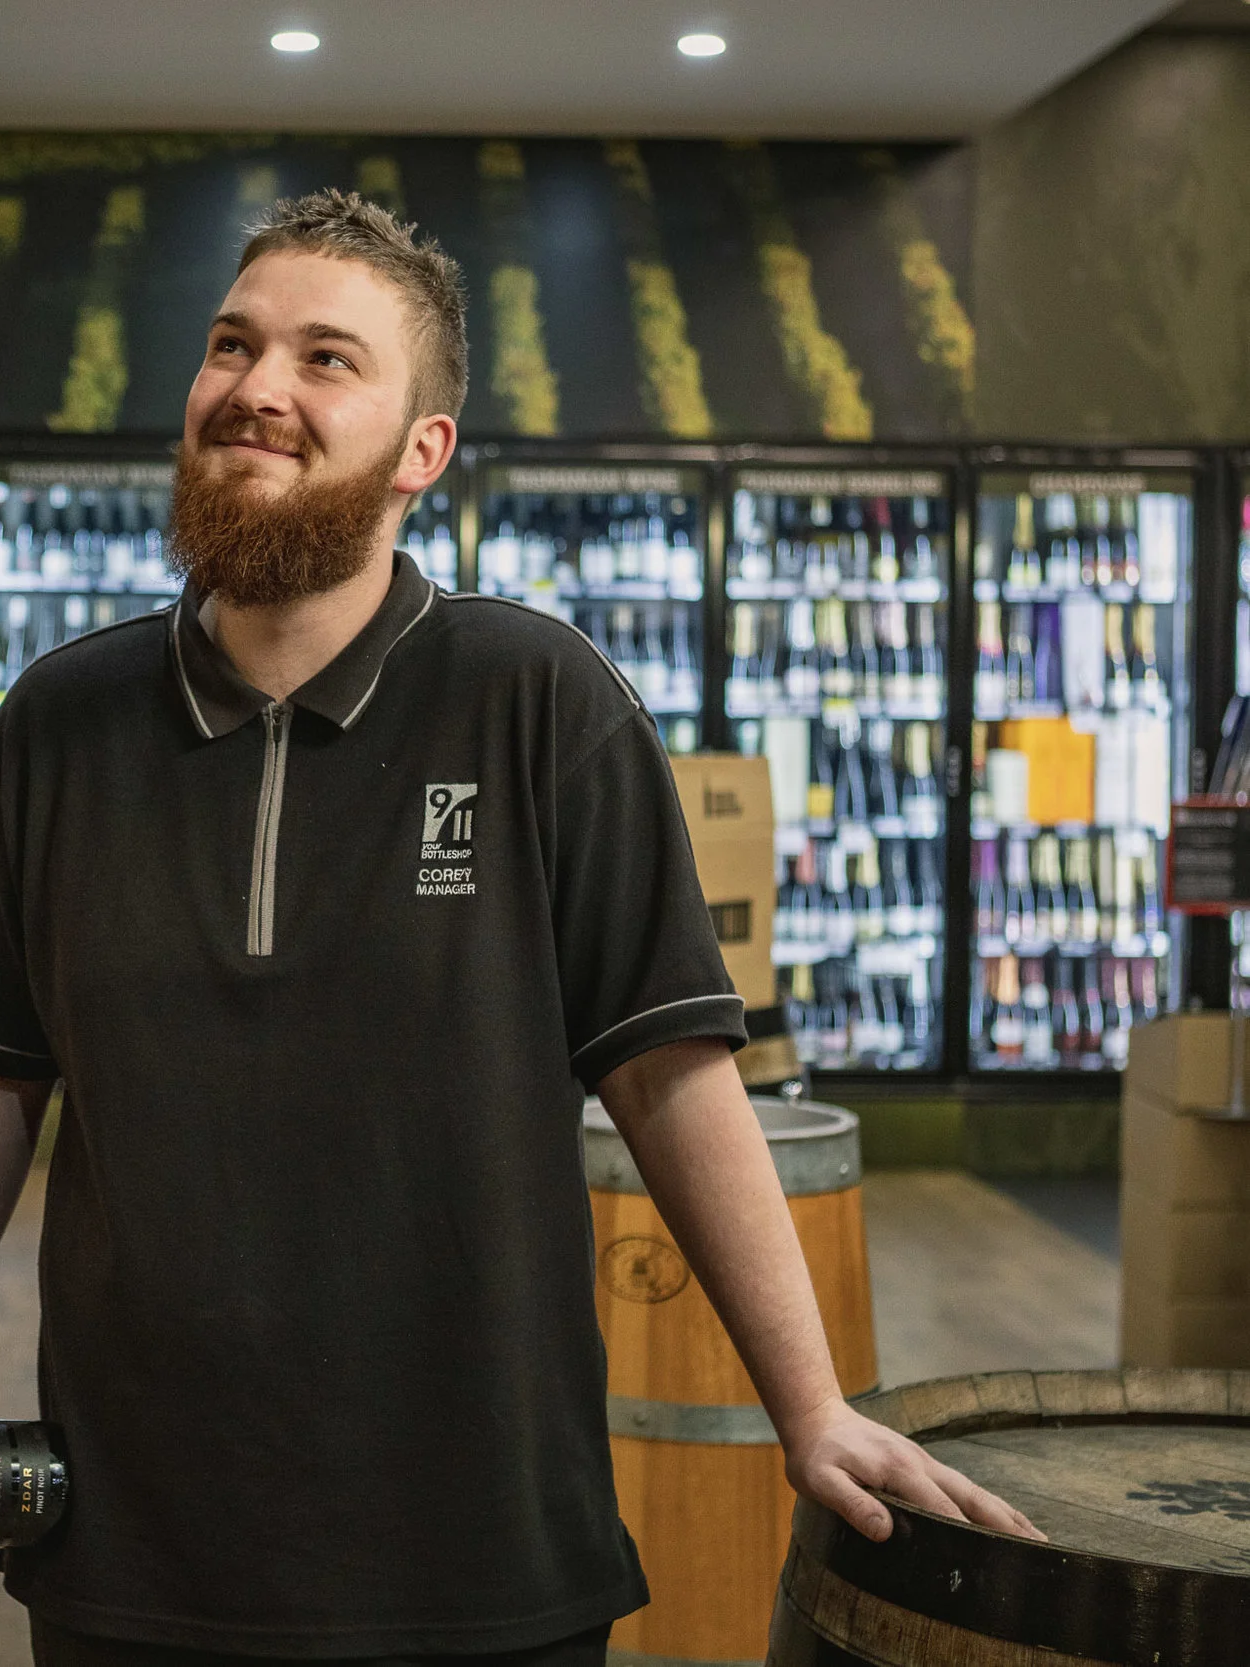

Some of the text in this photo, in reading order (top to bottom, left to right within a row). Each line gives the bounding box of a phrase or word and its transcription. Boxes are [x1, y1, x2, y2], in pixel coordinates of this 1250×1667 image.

[422, 843, 442, 851] your
[421, 849, 473, 860] BOTTLESHOP
[418, 867, 473, 883] COREY
[415, 883, 476, 896] MANAGER
[21, 1467, 33, 1513] ZDAR
[36, 1491, 44, 1514] PINOT
